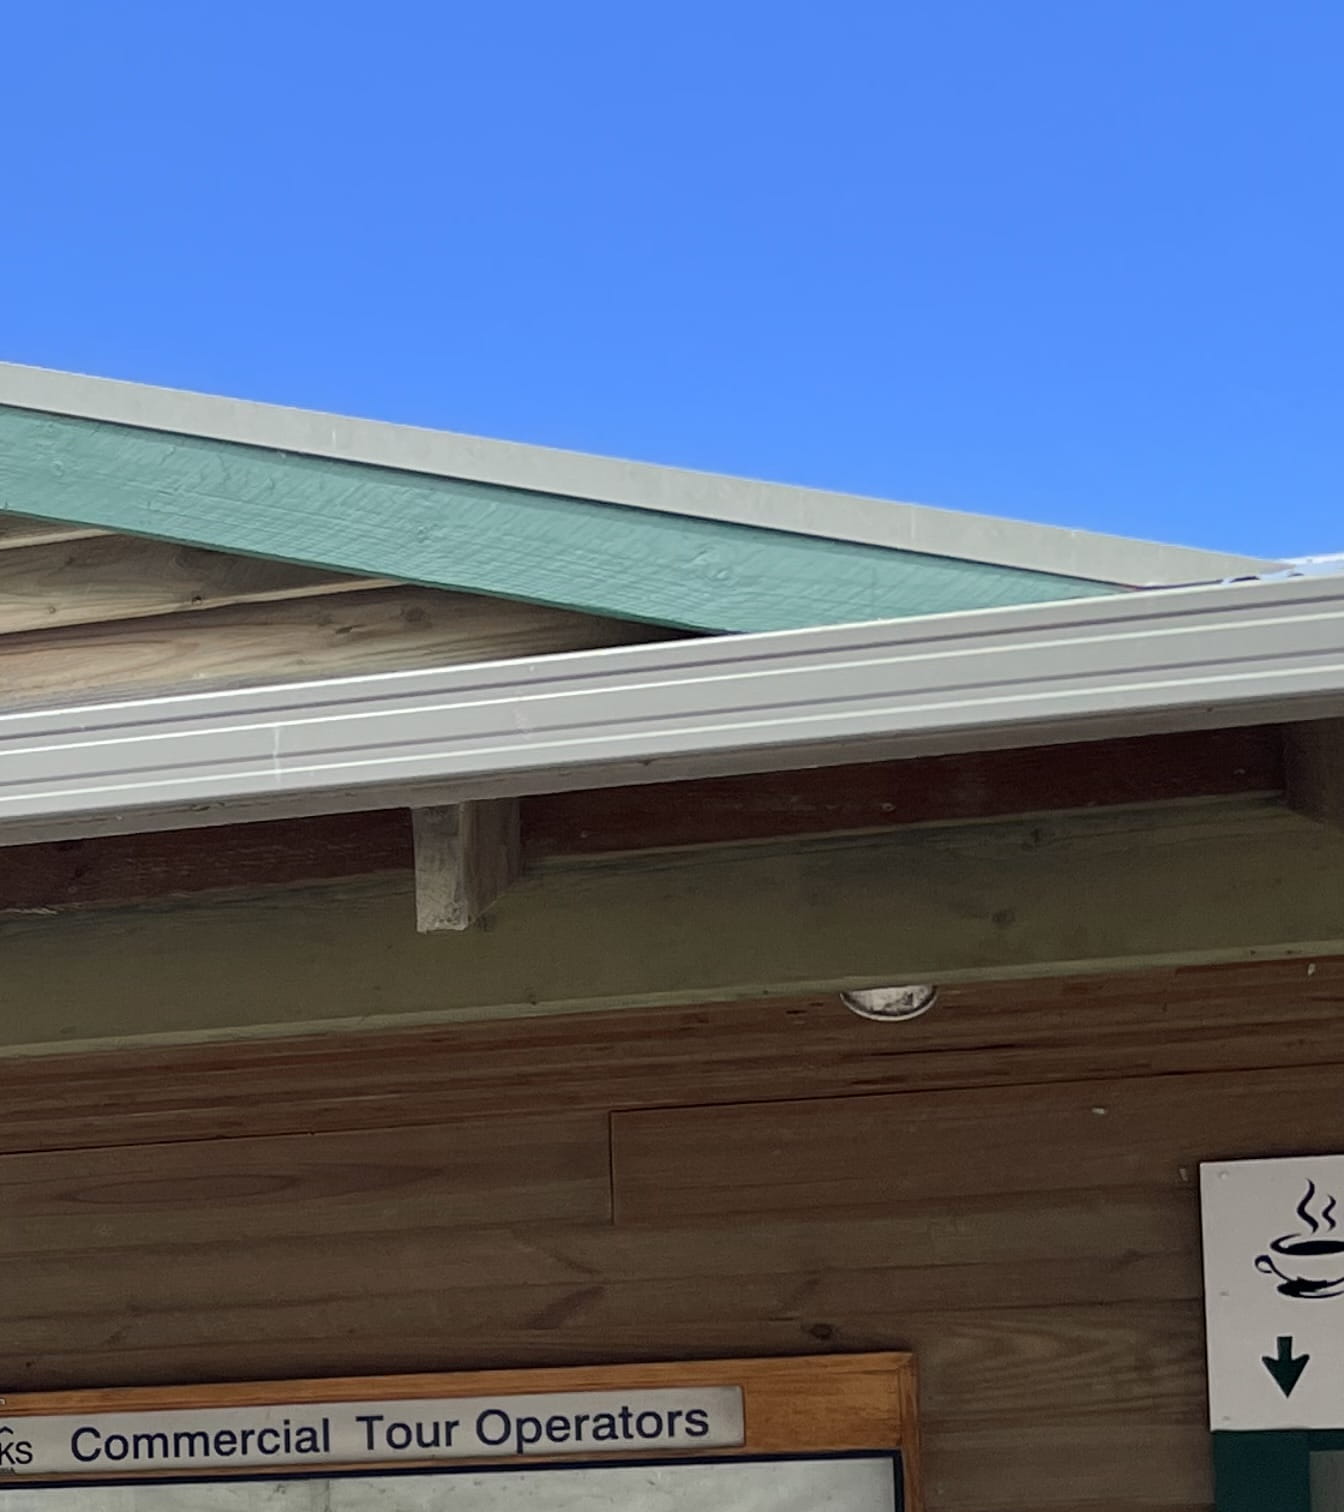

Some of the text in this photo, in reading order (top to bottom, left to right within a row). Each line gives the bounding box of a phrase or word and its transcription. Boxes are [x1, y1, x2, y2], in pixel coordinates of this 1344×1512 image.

[71, 1404, 711, 1462] Commercial Tour Operators
